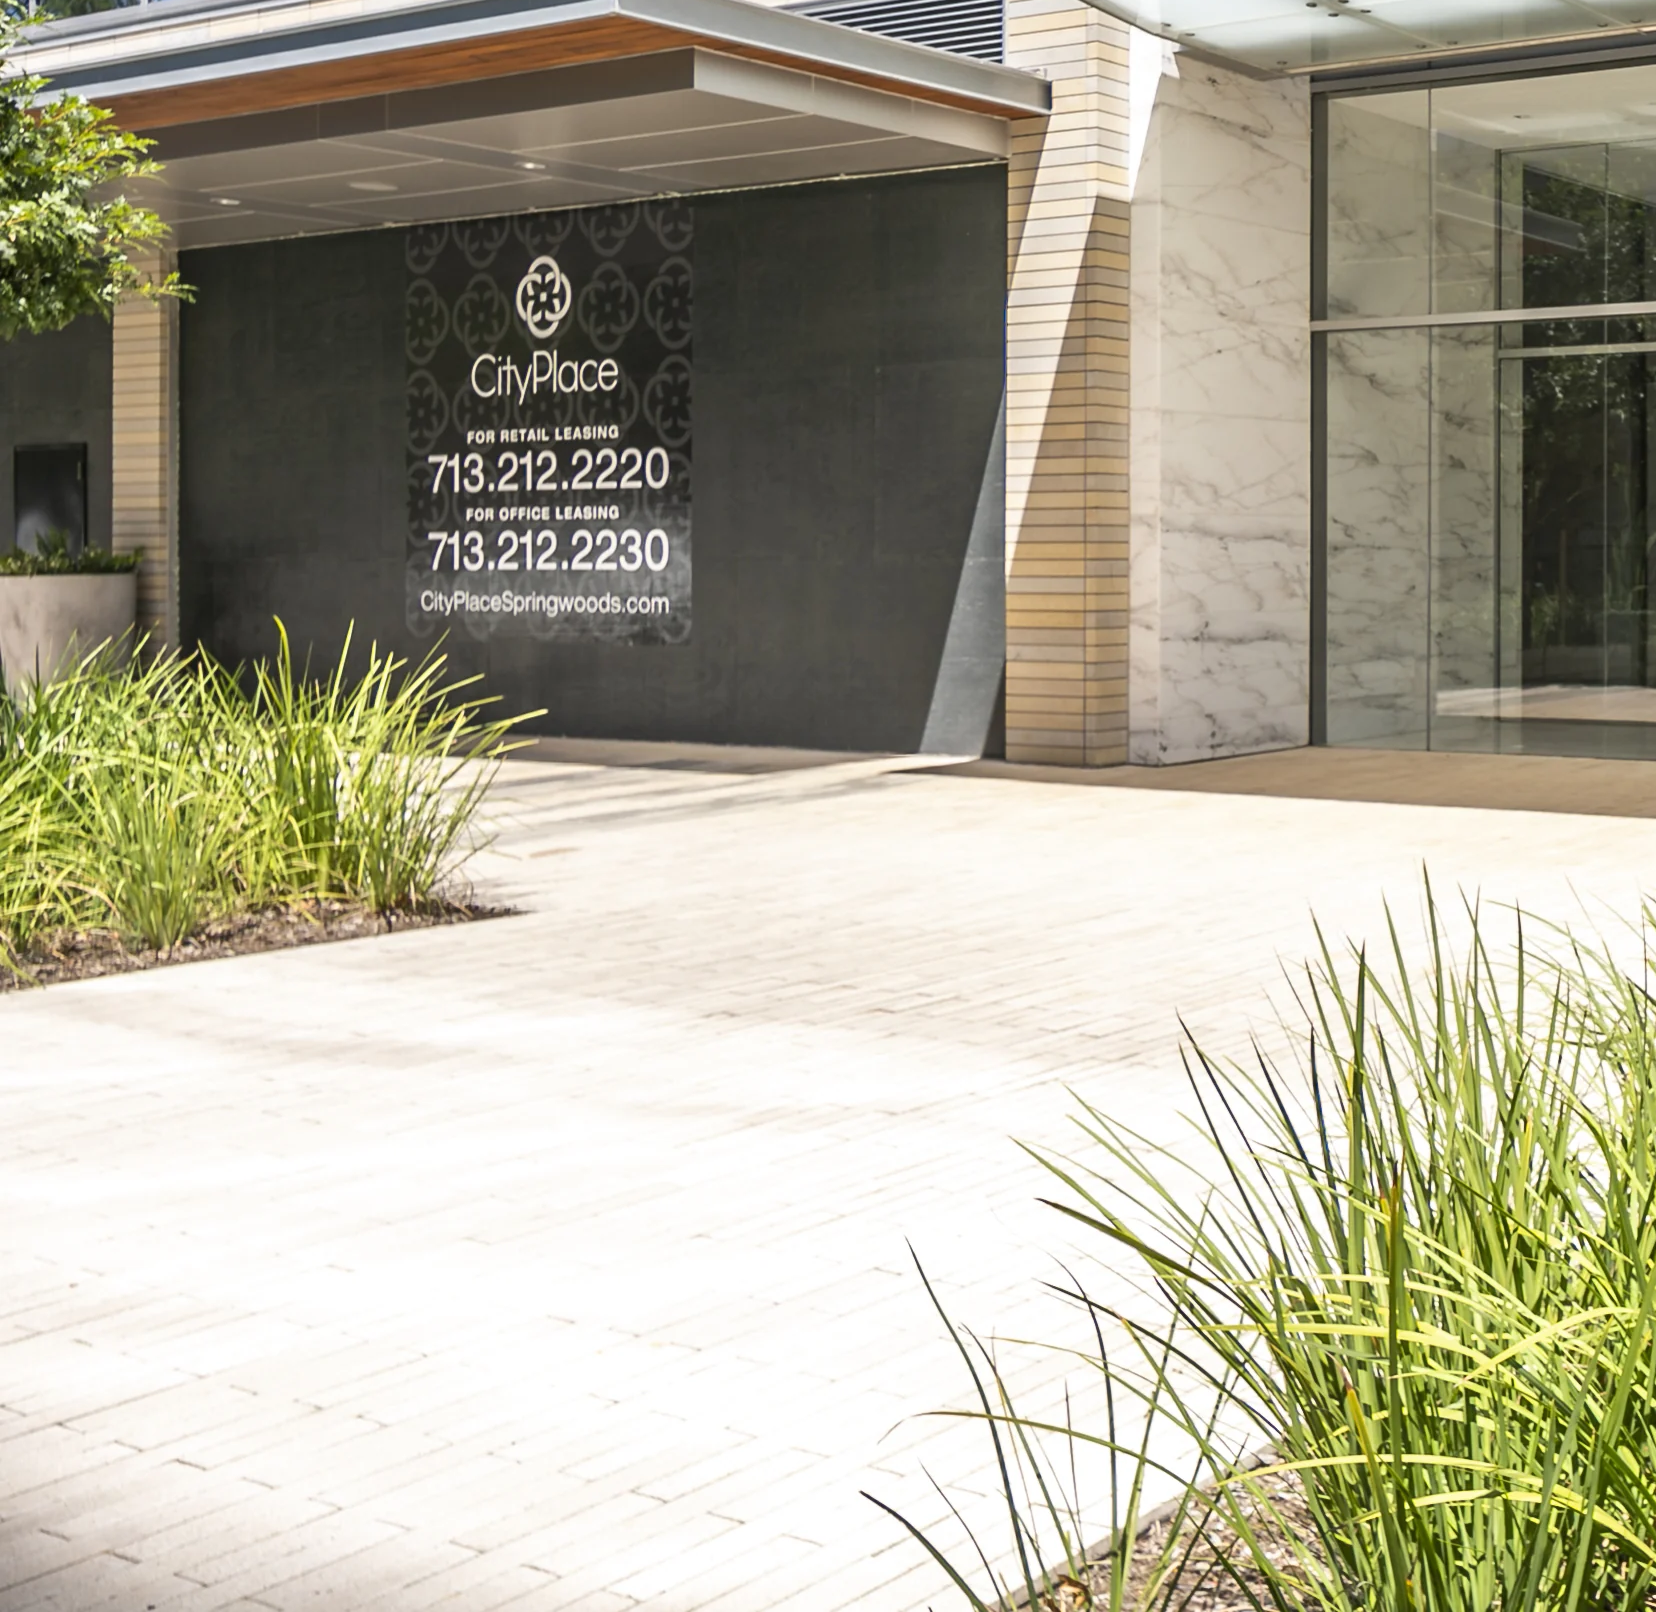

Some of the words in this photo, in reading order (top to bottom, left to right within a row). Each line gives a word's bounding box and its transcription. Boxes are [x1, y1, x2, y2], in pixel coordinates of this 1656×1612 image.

[470, 349, 619, 406] CityPlace
[466, 429, 496, 445] FOR
[499, 427, 550, 443] RETAIL
[554, 424, 620, 442] LEASING
[427, 446, 670, 494] 713.212.2220
[465, 507, 495, 522] FOR
[498, 505, 551, 522] OFFICE
[555, 504, 620, 521] LEASING
[427, 528, 670, 572] 713.212.2230
[420, 589, 670, 618] CityPlaceSpringwoods.com
